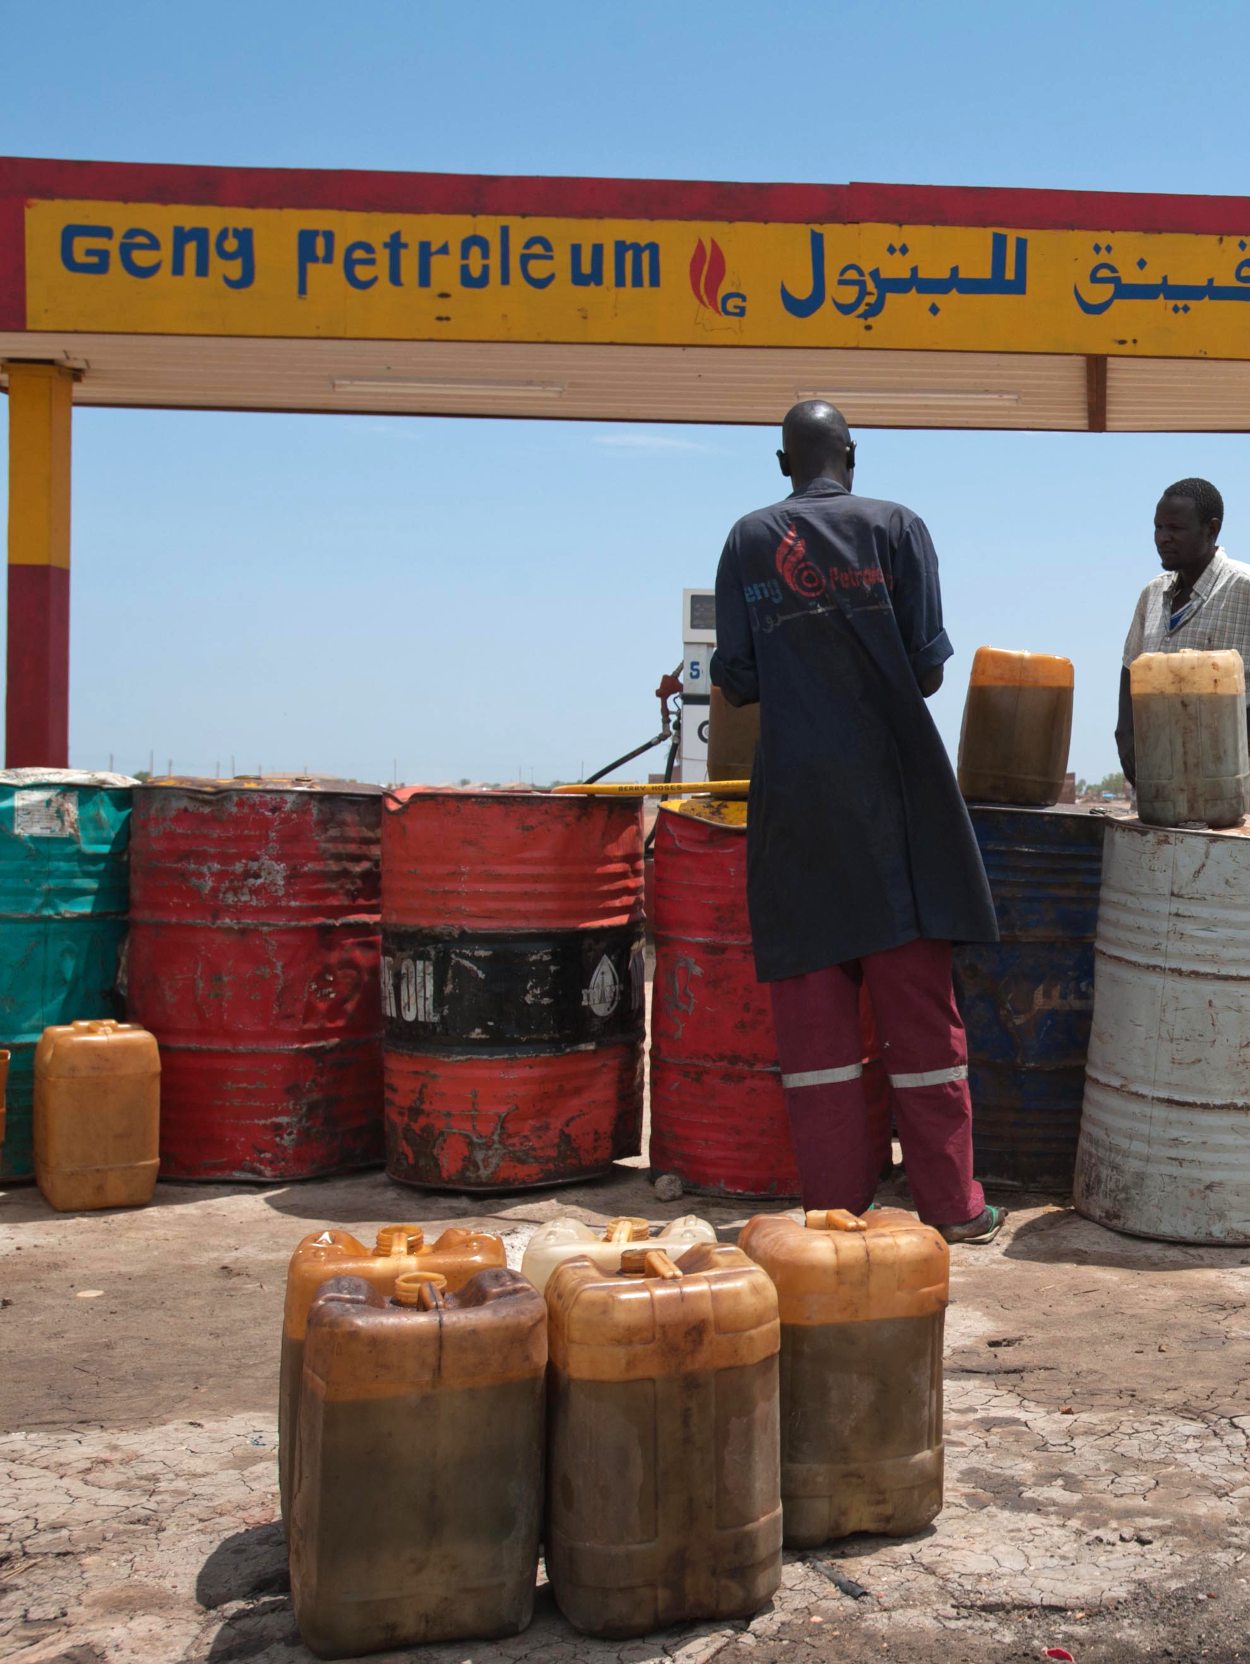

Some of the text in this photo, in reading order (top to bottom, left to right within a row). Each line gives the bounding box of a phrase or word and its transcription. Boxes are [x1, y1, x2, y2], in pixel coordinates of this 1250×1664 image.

[60, 224, 256, 290] Geng
[780, 229, 1028, 319] للبترول
[721, 292, 747, 317] G
[401, 958, 440, 1023] OIL
